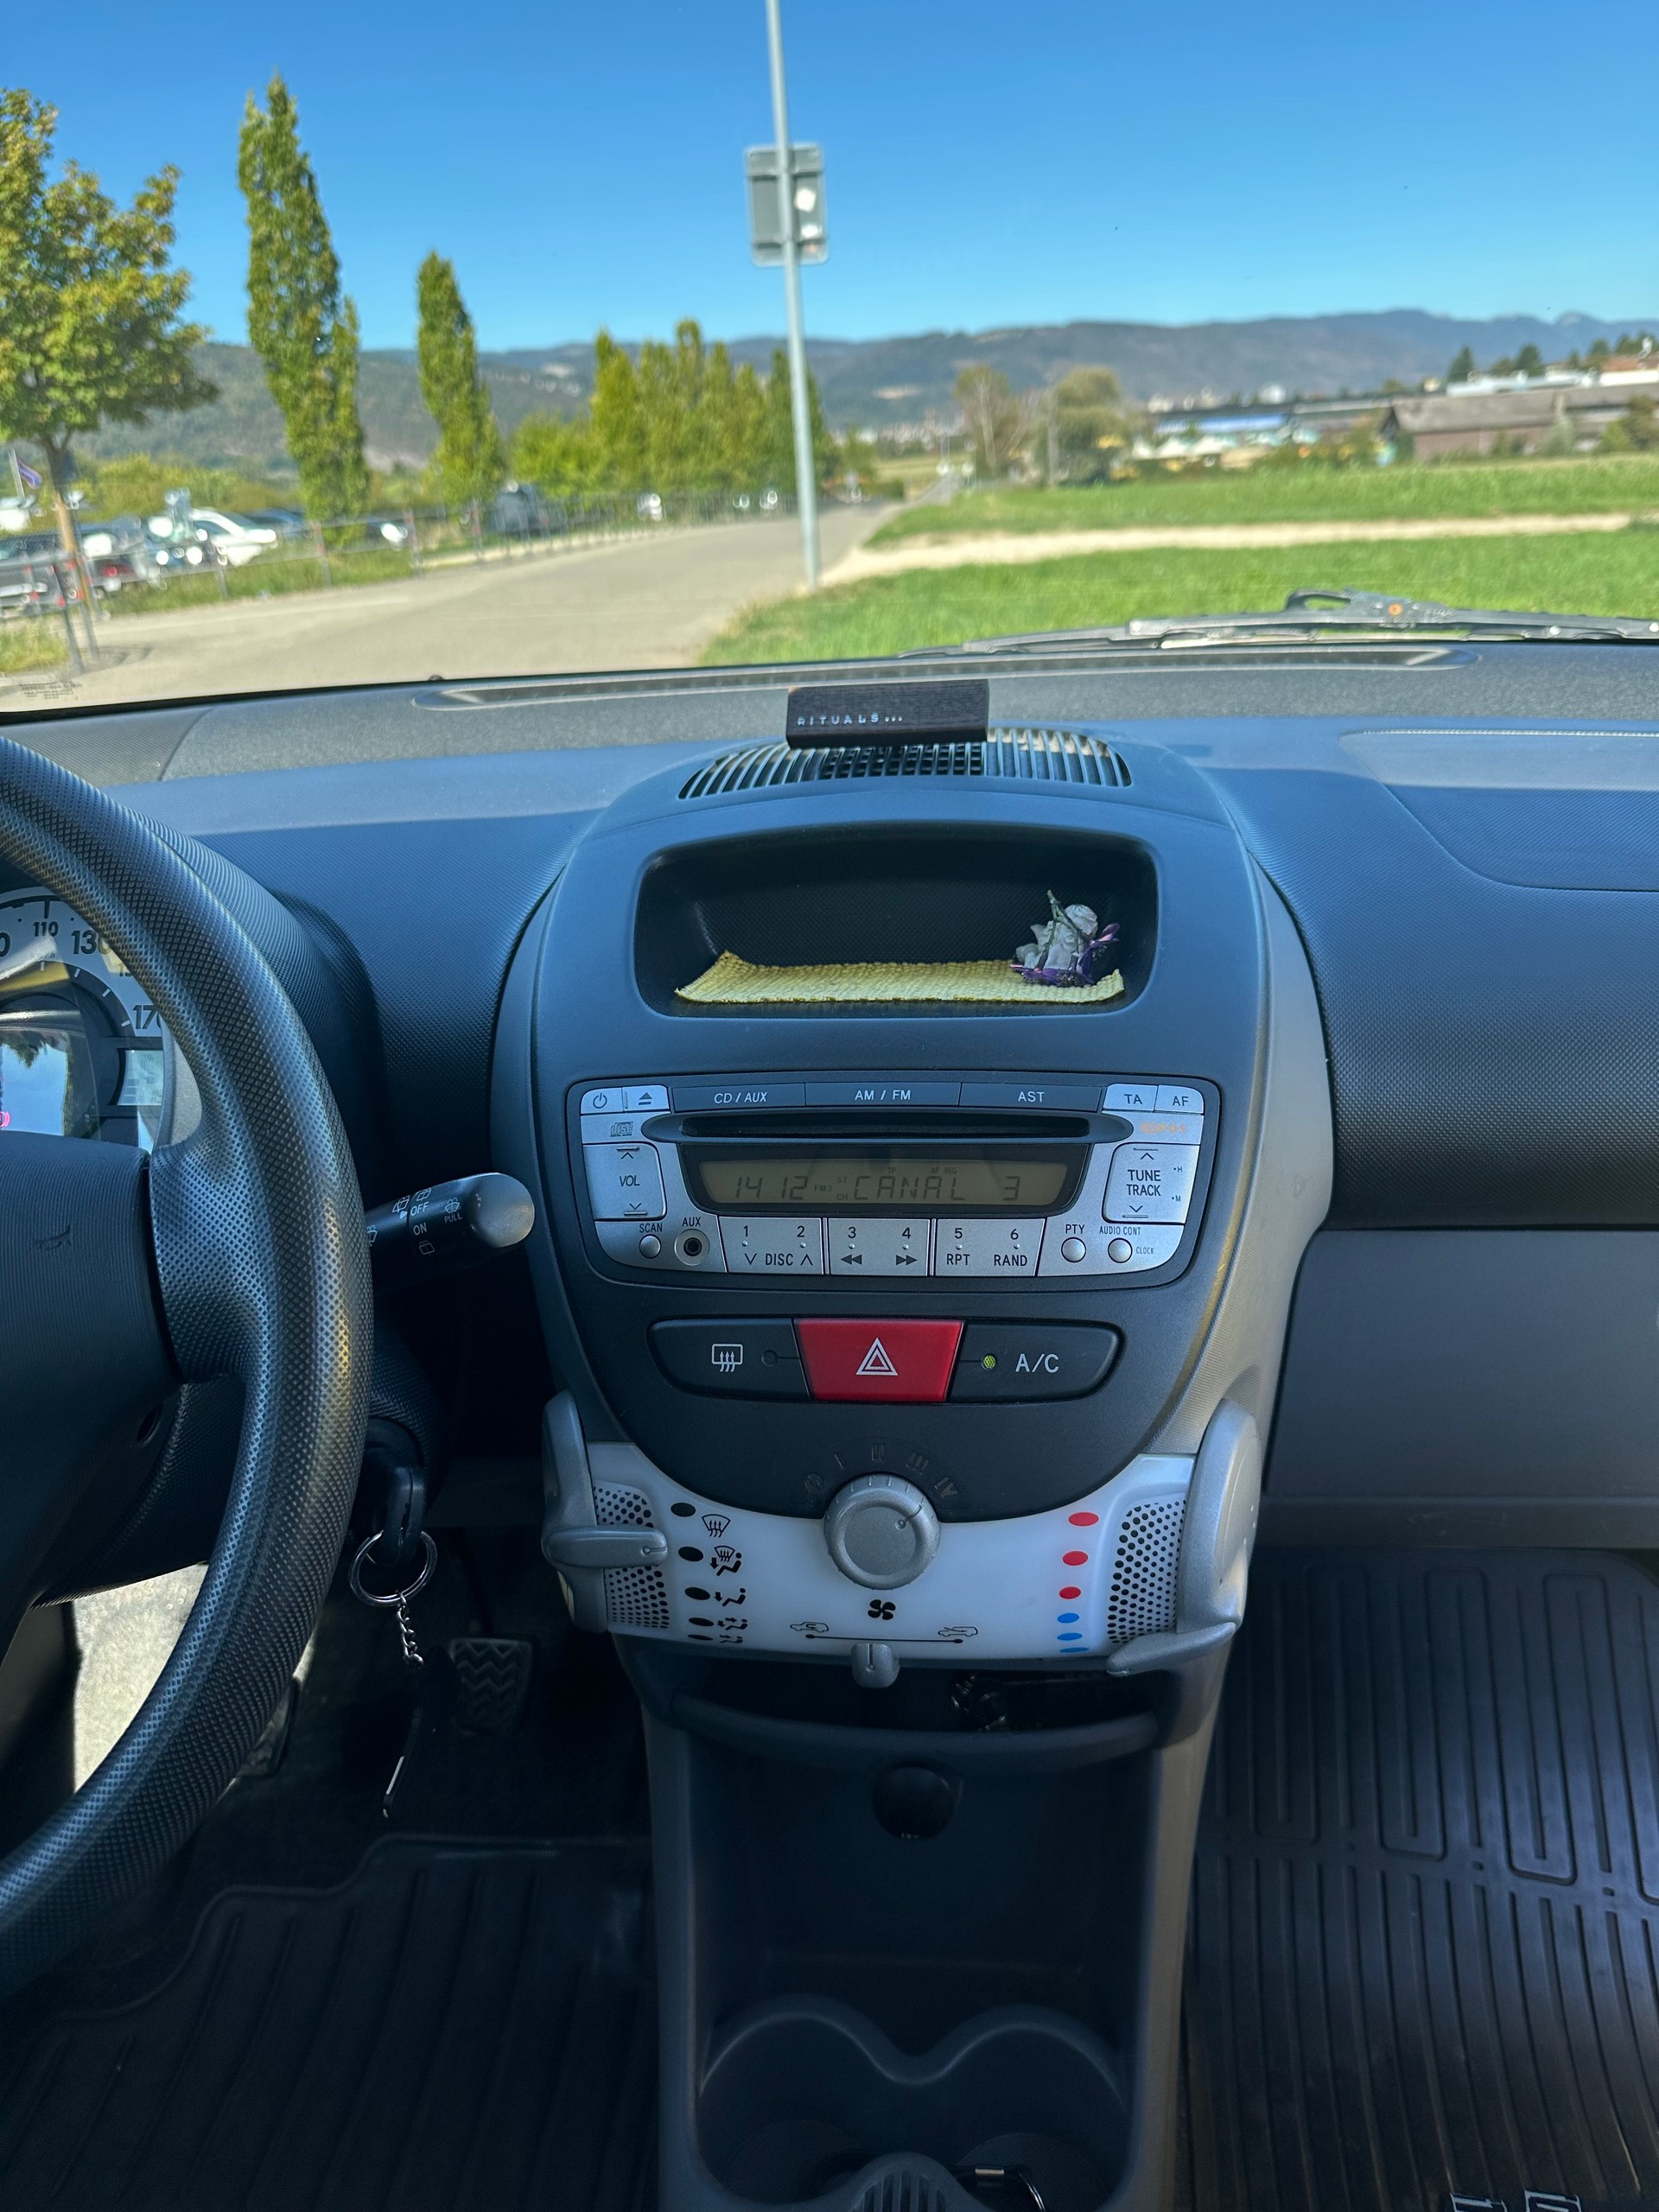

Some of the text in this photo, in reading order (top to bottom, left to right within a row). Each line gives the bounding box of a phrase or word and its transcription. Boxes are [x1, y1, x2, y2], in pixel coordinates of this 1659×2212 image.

[1017, 1090, 1045, 1103] AST
[1123, 1094, 1143, 1106] TA
[1172, 1096, 1189, 1107] AF
[619, 1175, 640, 1187] VOL
[1127, 1169, 1161, 1182] TUNE
[854, 1175, 1021, 1201] CANAL 3
[1126, 1184, 1161, 1197] TRACK
[410, 1202, 429, 1217] OFF
[444, 1211, 463, 1224] PULL
[682, 1217, 702, 1228] AUX
[413, 1223, 427, 1236] ON
[639, 1223, 663, 1234] SCAN
[743, 1225, 749, 1238] 1
[797, 1225, 805, 1238] 2
[847, 1226, 857, 1239] 3
[901, 1227, 912, 1239] 4
[954, 1227, 963, 1239] 5
[1010, 1228, 1020, 1240] 6
[1065, 1224, 1085, 1235] PTY
[1099, 1225, 1141, 1236] AUDIO CONT
[1135, 1246, 1154, 1255] CLOCK
[765, 1253, 794, 1266] DISC
[946, 1253, 970, 1266] RPT
[994, 1255, 1028, 1267] RAND
[1015, 1352, 1059, 1373] A/C
